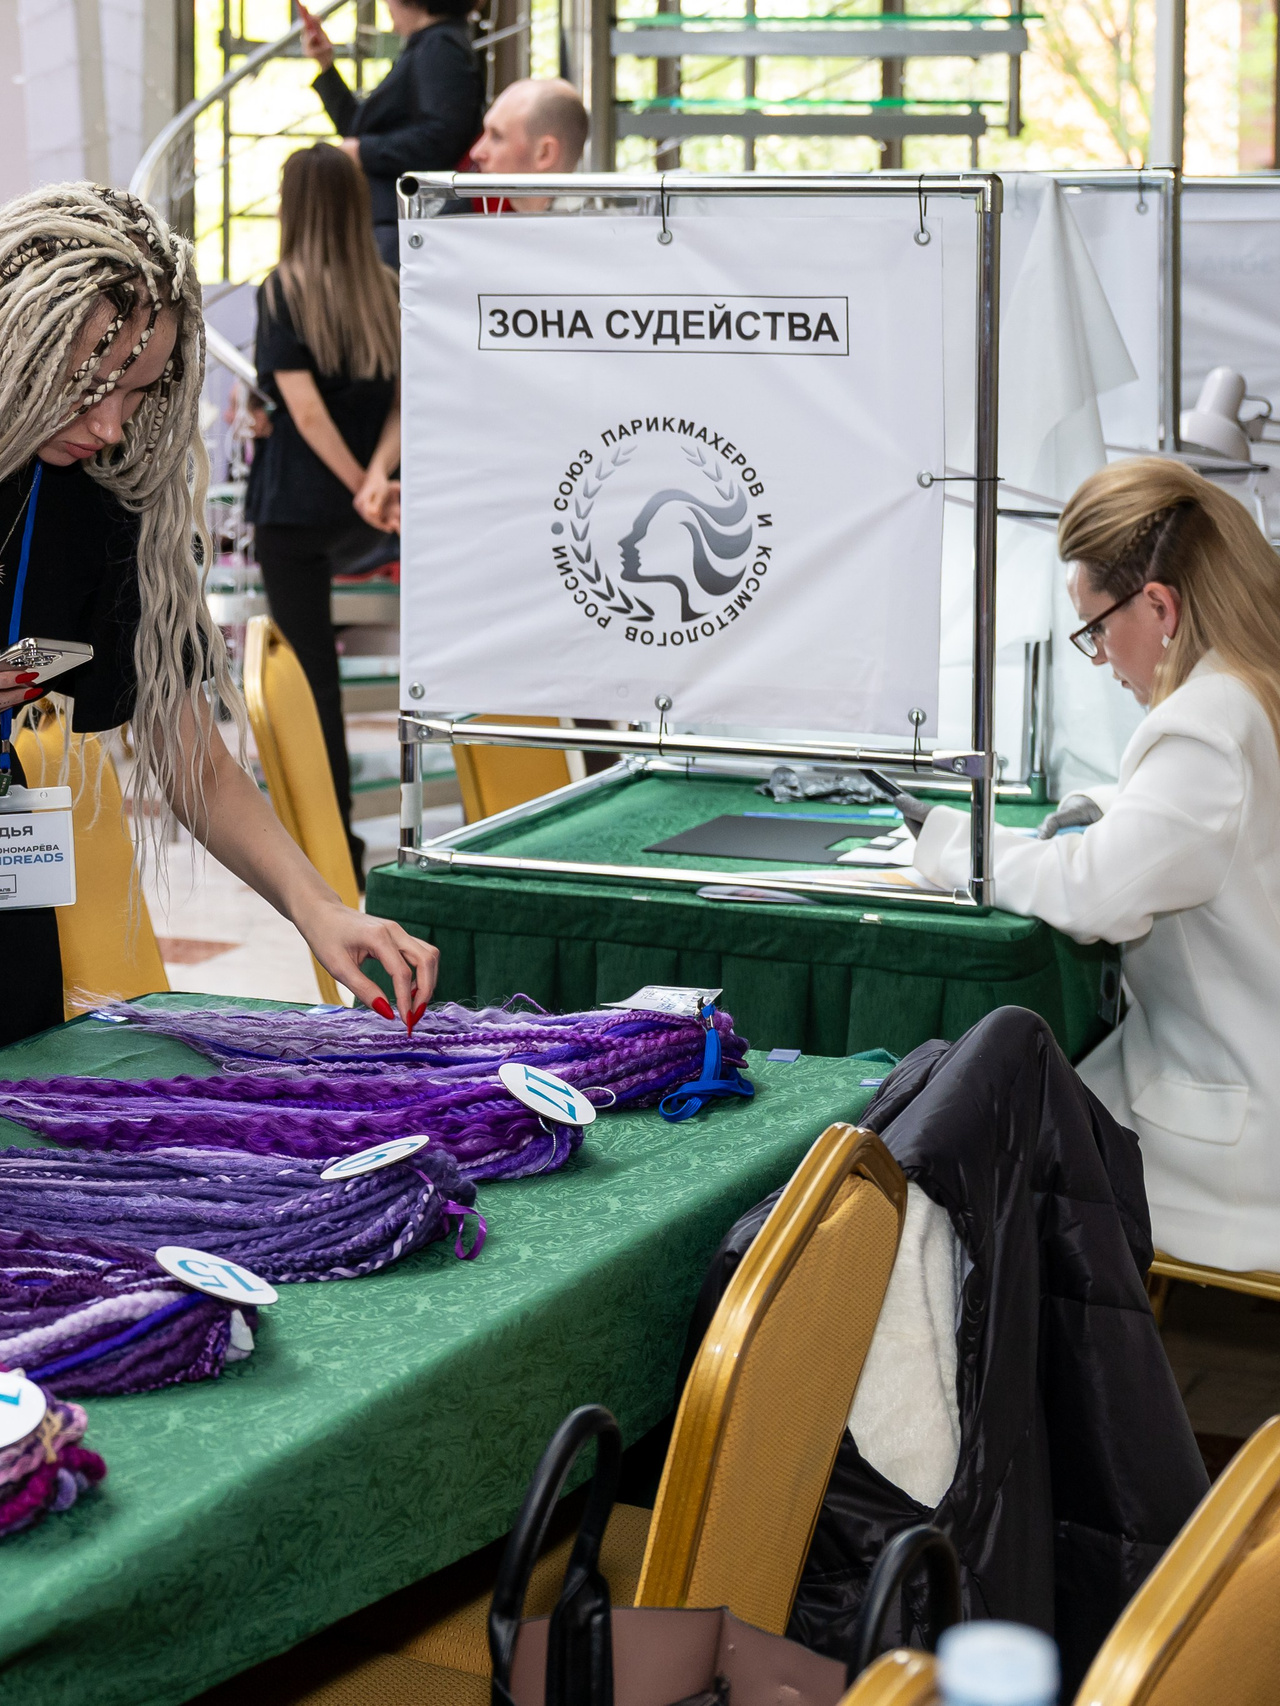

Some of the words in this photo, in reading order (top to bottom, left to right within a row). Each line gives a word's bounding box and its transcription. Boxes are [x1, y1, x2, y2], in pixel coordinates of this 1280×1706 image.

[487, 308, 594, 341] ЗОНА
[605, 303, 840, 345] СУДЕЙСТВА
[553, 448, 594, 513] СОЮЗ
[600, 415, 765, 499] ПАРИКМАХЕРОВ
[757, 513, 774, 529] И
[551, 545, 612, 630] РОССИИ
[624, 544, 773, 648] КОСМЕТОЛОГОВ
[523, 1066, 577, 1121] 17
[177, 1259, 264, 1292] 15
